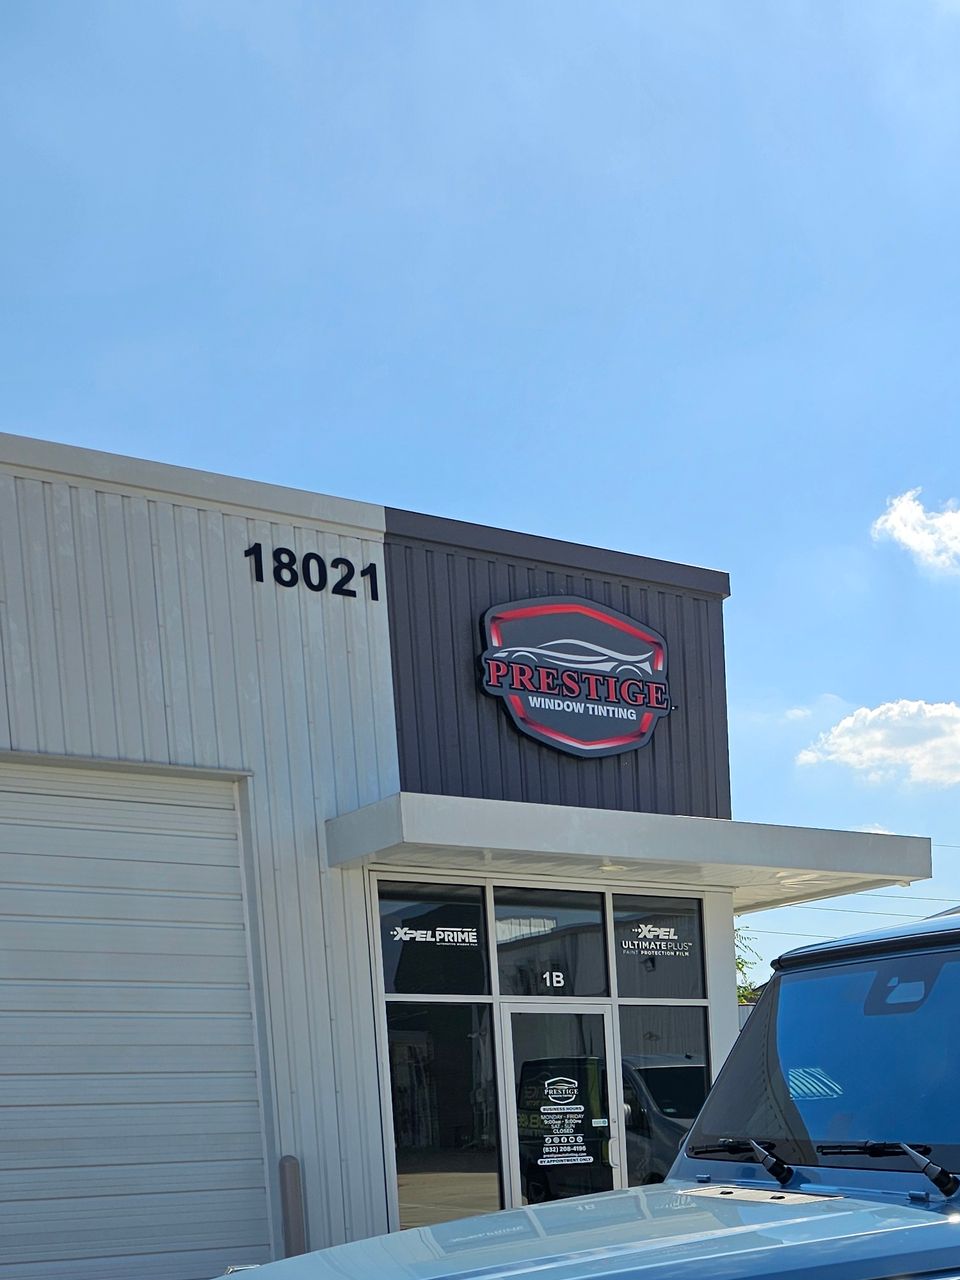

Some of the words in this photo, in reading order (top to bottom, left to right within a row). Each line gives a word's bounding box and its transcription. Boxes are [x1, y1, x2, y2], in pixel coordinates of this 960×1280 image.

[244, 542, 379, 601] 18021
[486, 659, 668, 709] PRESTIGE
[528, 696, 585, 714] WINDOW
[588, 704, 637, 721] TINTING
[637, 923, 678, 940] XPEL
[542, 971, 565, 987] 1B
